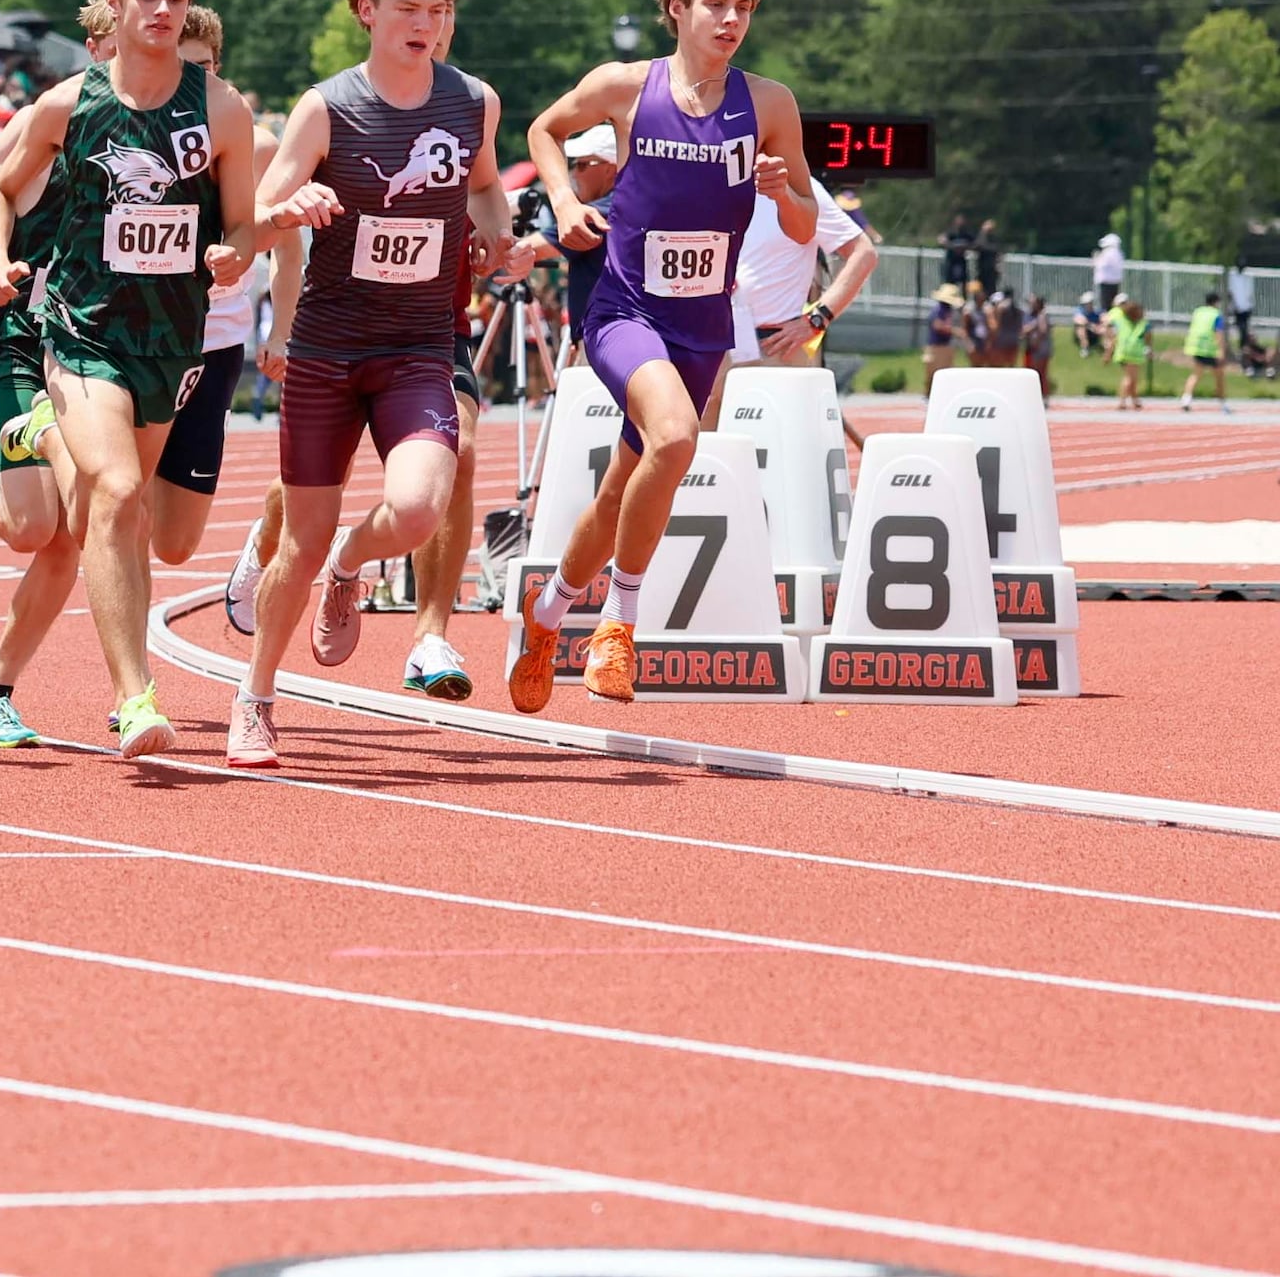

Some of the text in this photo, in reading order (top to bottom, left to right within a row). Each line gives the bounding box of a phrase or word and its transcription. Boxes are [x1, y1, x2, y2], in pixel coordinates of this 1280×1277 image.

[179, 131, 207, 173] 8
[429, 142, 455, 184] 3
[730, 141, 745, 180] 1
[118, 222, 190, 254] 6074
[371, 234, 428, 265] 987
[662, 248, 714, 279] 898
[177, 370, 201, 407] 8
[735, 408, 763, 420] GILL
[957, 406, 997, 419] GILL
[890, 474, 933, 487] GILL
[664, 515, 728, 630] 7
[866, 515, 950, 630] 8
[828, 651, 987, 689] GEORGIA
